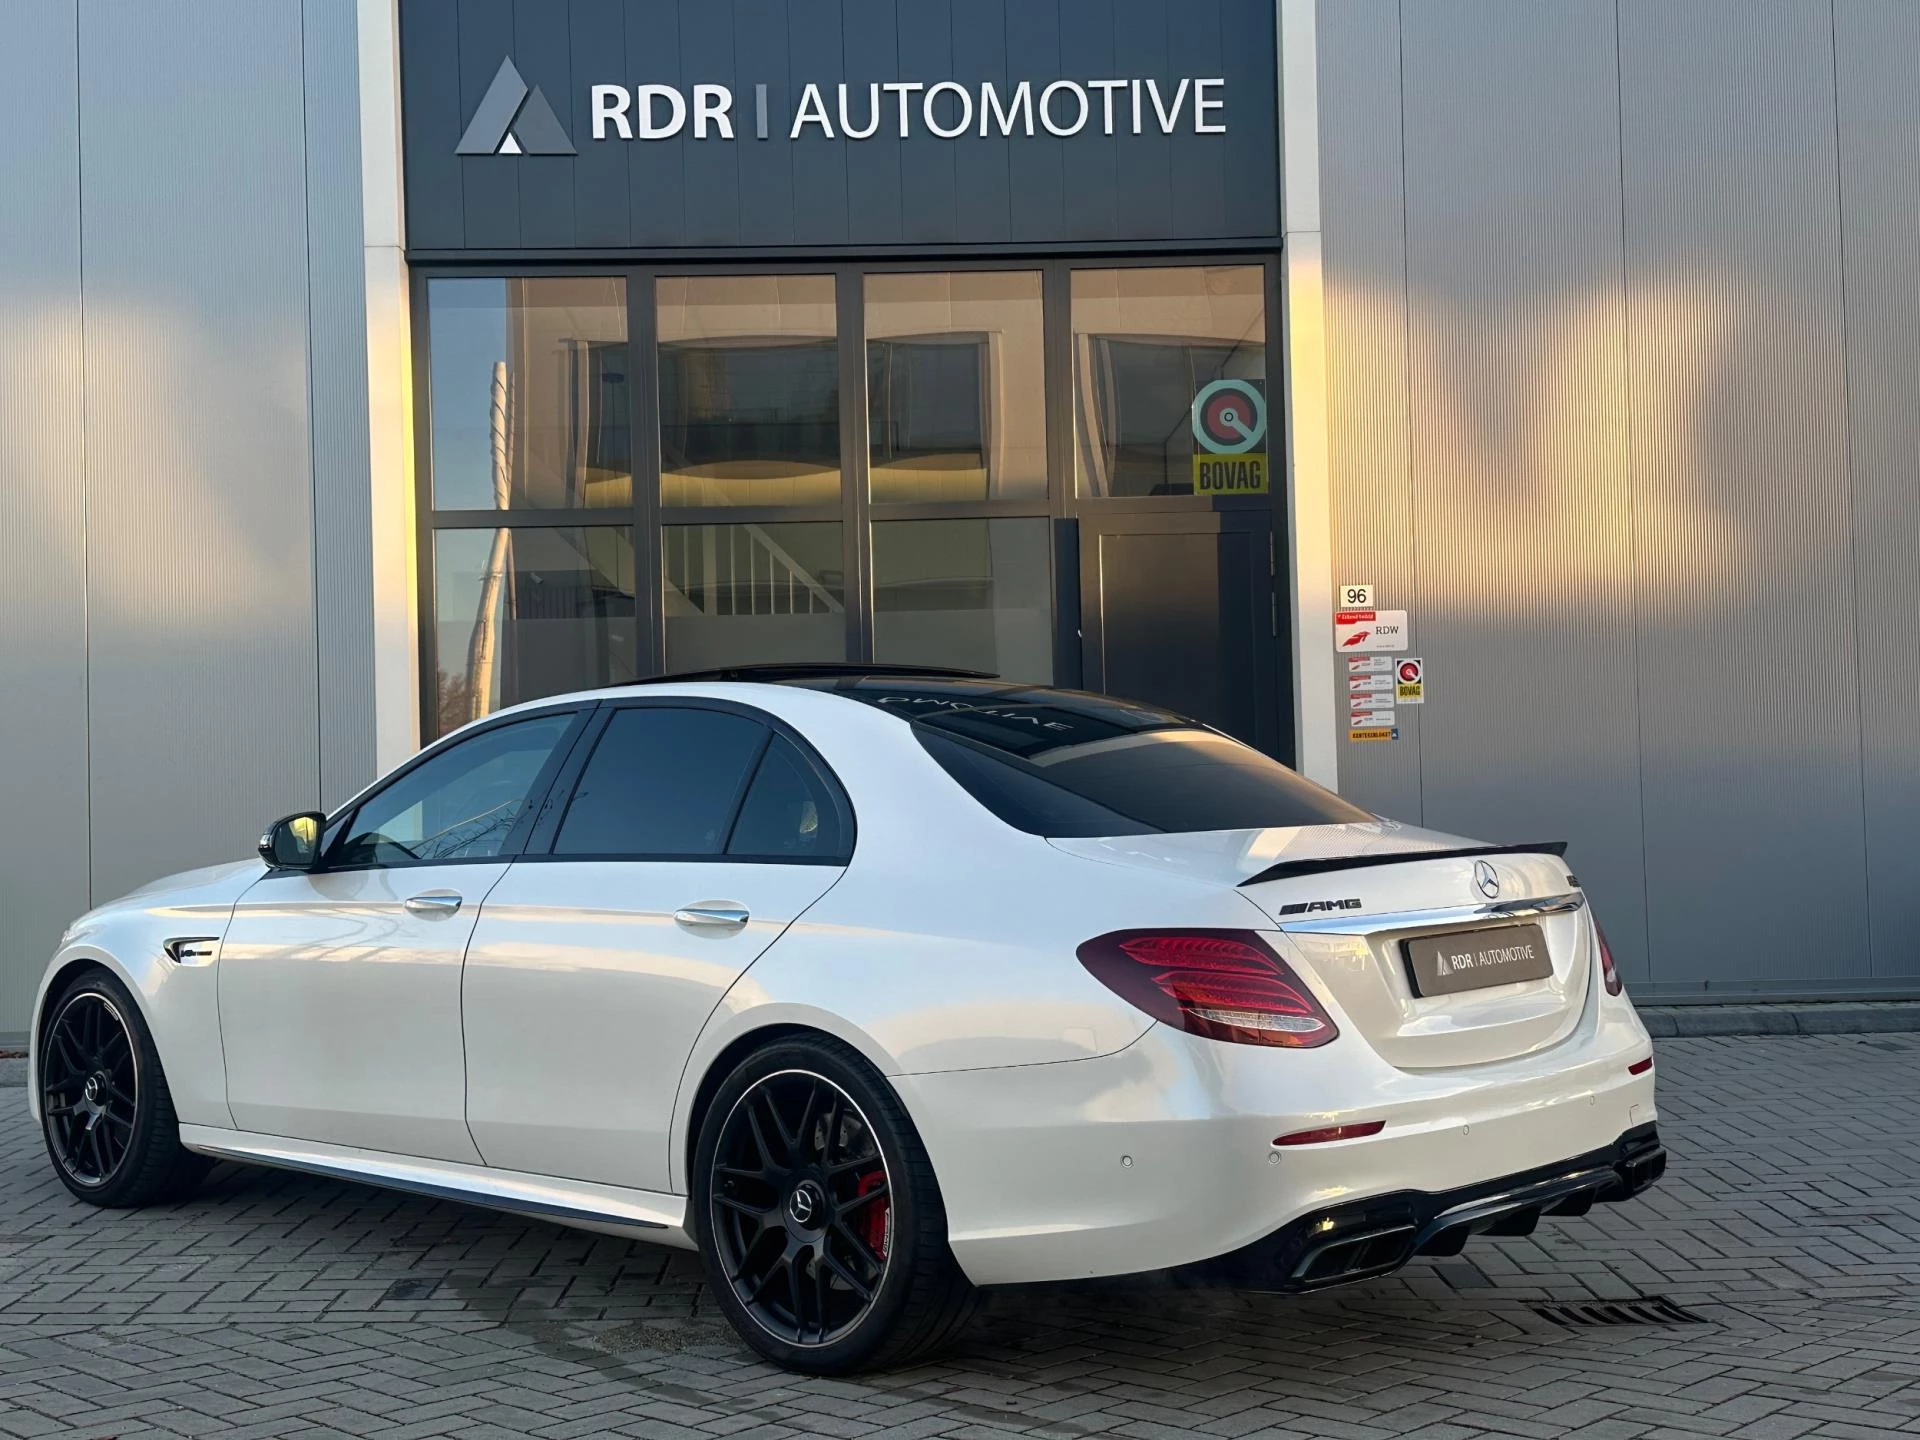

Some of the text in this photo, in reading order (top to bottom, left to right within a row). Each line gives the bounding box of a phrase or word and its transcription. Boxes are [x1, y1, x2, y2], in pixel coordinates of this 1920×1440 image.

[590, 77, 1227, 140] RDR AUTOMOTIVE
[1199, 461, 1261, 490] BOVAG
[1347, 588, 1367, 604] 96
[1375, 626, 1399, 635] RDW
[1399, 685, 1421, 696] BOVAG
[1306, 898, 1362, 913] AMG
[1450, 944, 1535, 970] RDR AUTOMOTIVE
